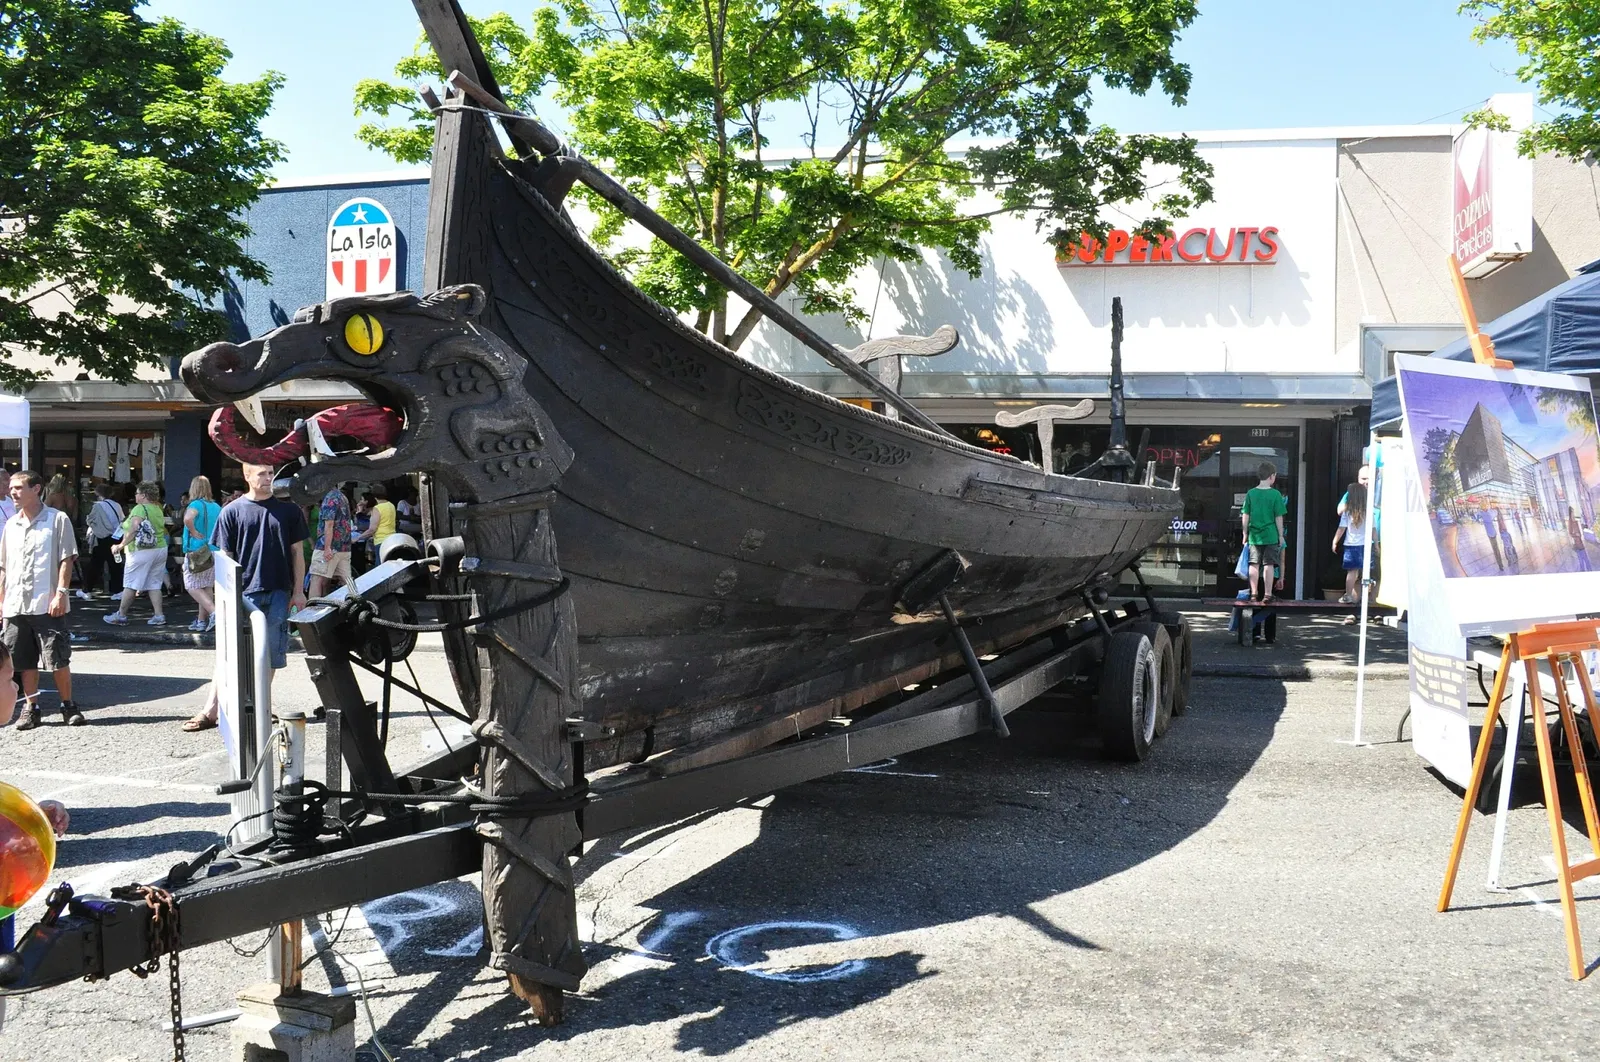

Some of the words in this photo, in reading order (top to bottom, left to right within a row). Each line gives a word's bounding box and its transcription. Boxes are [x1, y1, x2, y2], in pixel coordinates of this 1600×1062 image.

[331, 228, 353, 253] La
[358, 226, 392, 250] Isla
[1145, 447, 1200, 467] OPEN
